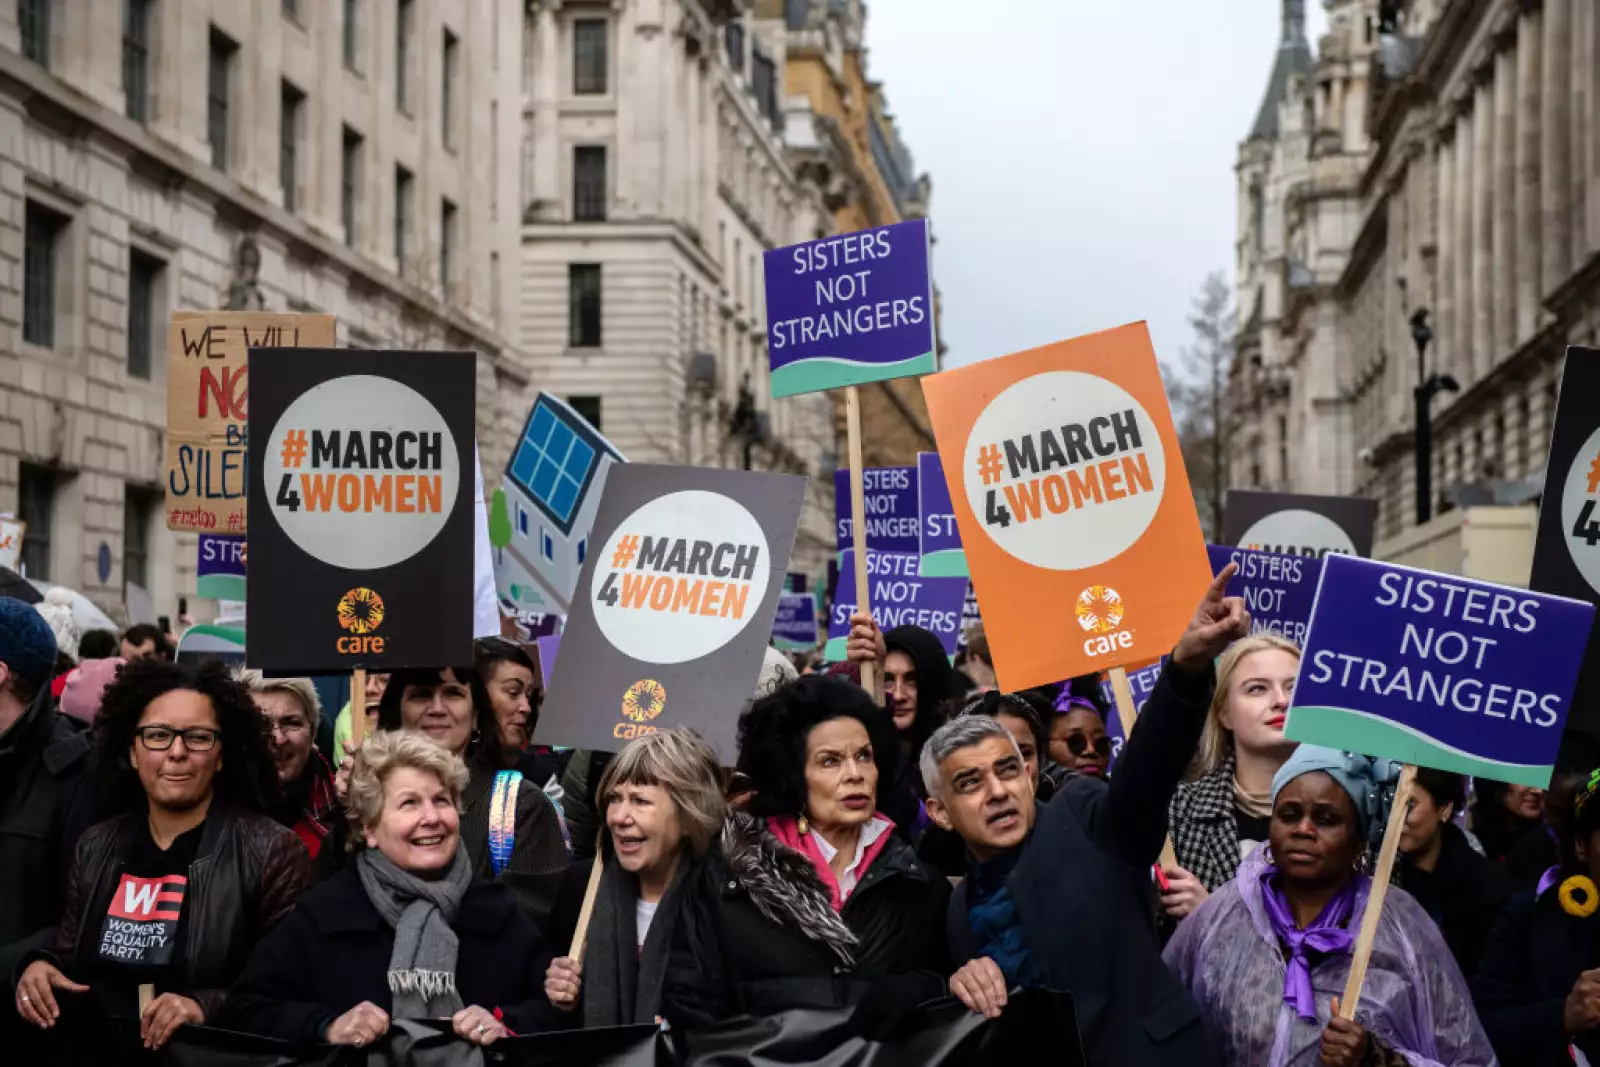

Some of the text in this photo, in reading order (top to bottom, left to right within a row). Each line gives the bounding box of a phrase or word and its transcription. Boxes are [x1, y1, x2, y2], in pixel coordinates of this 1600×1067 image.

[793, 230, 891, 274] SISTERS
[815, 270, 871, 306] NOT
[773, 296, 924, 348] STRANGERS
[181, 326, 227, 358] WE
[198, 364, 248, 420] NO
[280, 429, 442, 470] #MARCH
[977, 408, 1142, 485] #MARCH
[170, 444, 247, 498] SILE
[863, 470, 909, 490] STERS
[276, 473, 442, 513] 4WOMEN
[864, 494, 898, 514] NOT
[985, 452, 1154, 528] 4WOMEN
[839, 517, 919, 538] STANGER
[612, 535, 759, 580] #MARCH
[866, 553, 920, 577] SISTE
[1231, 551, 1303, 584] SISTERS
[597, 572, 749, 620] 4WOMEN
[874, 580, 922, 602] NOT
[1243, 585, 1286, 612] NOT
[1375, 572, 1540, 633] SISTERS
[835, 604, 957, 632] STANGERS
[336, 636, 385, 654] care
[1084, 629, 1134, 657] care
[1400, 623, 1497, 669] NOT
[1309, 650, 1562, 727] STRANGERS
[125, 873, 187, 920] WE
[103, 931, 168, 948] EQUALITY
[109, 919, 165, 936] WOMEN'S
[100, 943, 144, 960] PARTY.
